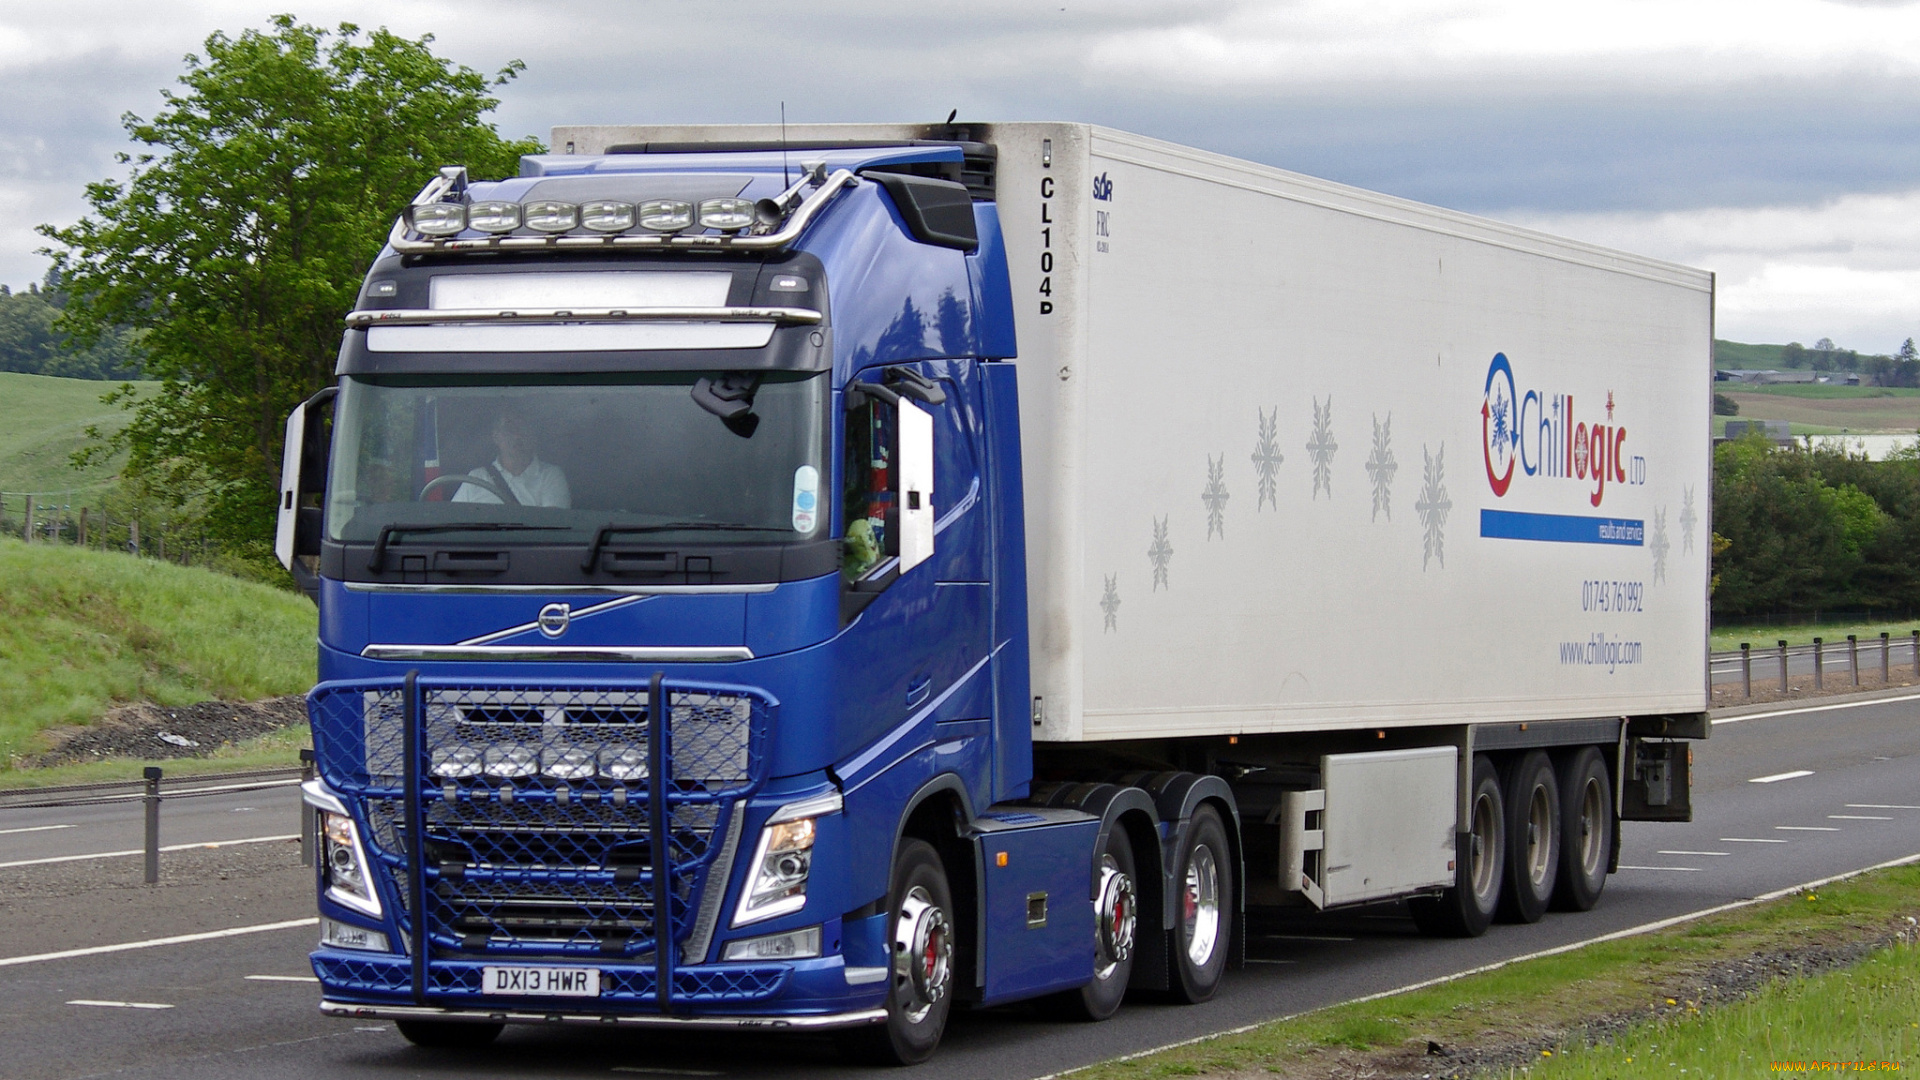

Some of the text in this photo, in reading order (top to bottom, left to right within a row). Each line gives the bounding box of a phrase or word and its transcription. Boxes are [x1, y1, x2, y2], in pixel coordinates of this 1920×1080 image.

[1096, 210, 1110, 238] FRC
[1520, 388, 1647, 508] Chillogic LTD
[1599, 520, 1643, 541] results and service
[1583, 580, 1644, 612] 01743 761992
[1560, 632, 1642, 675] www.chillogic.com
[496, 970, 588, 991] DX13 HWR
